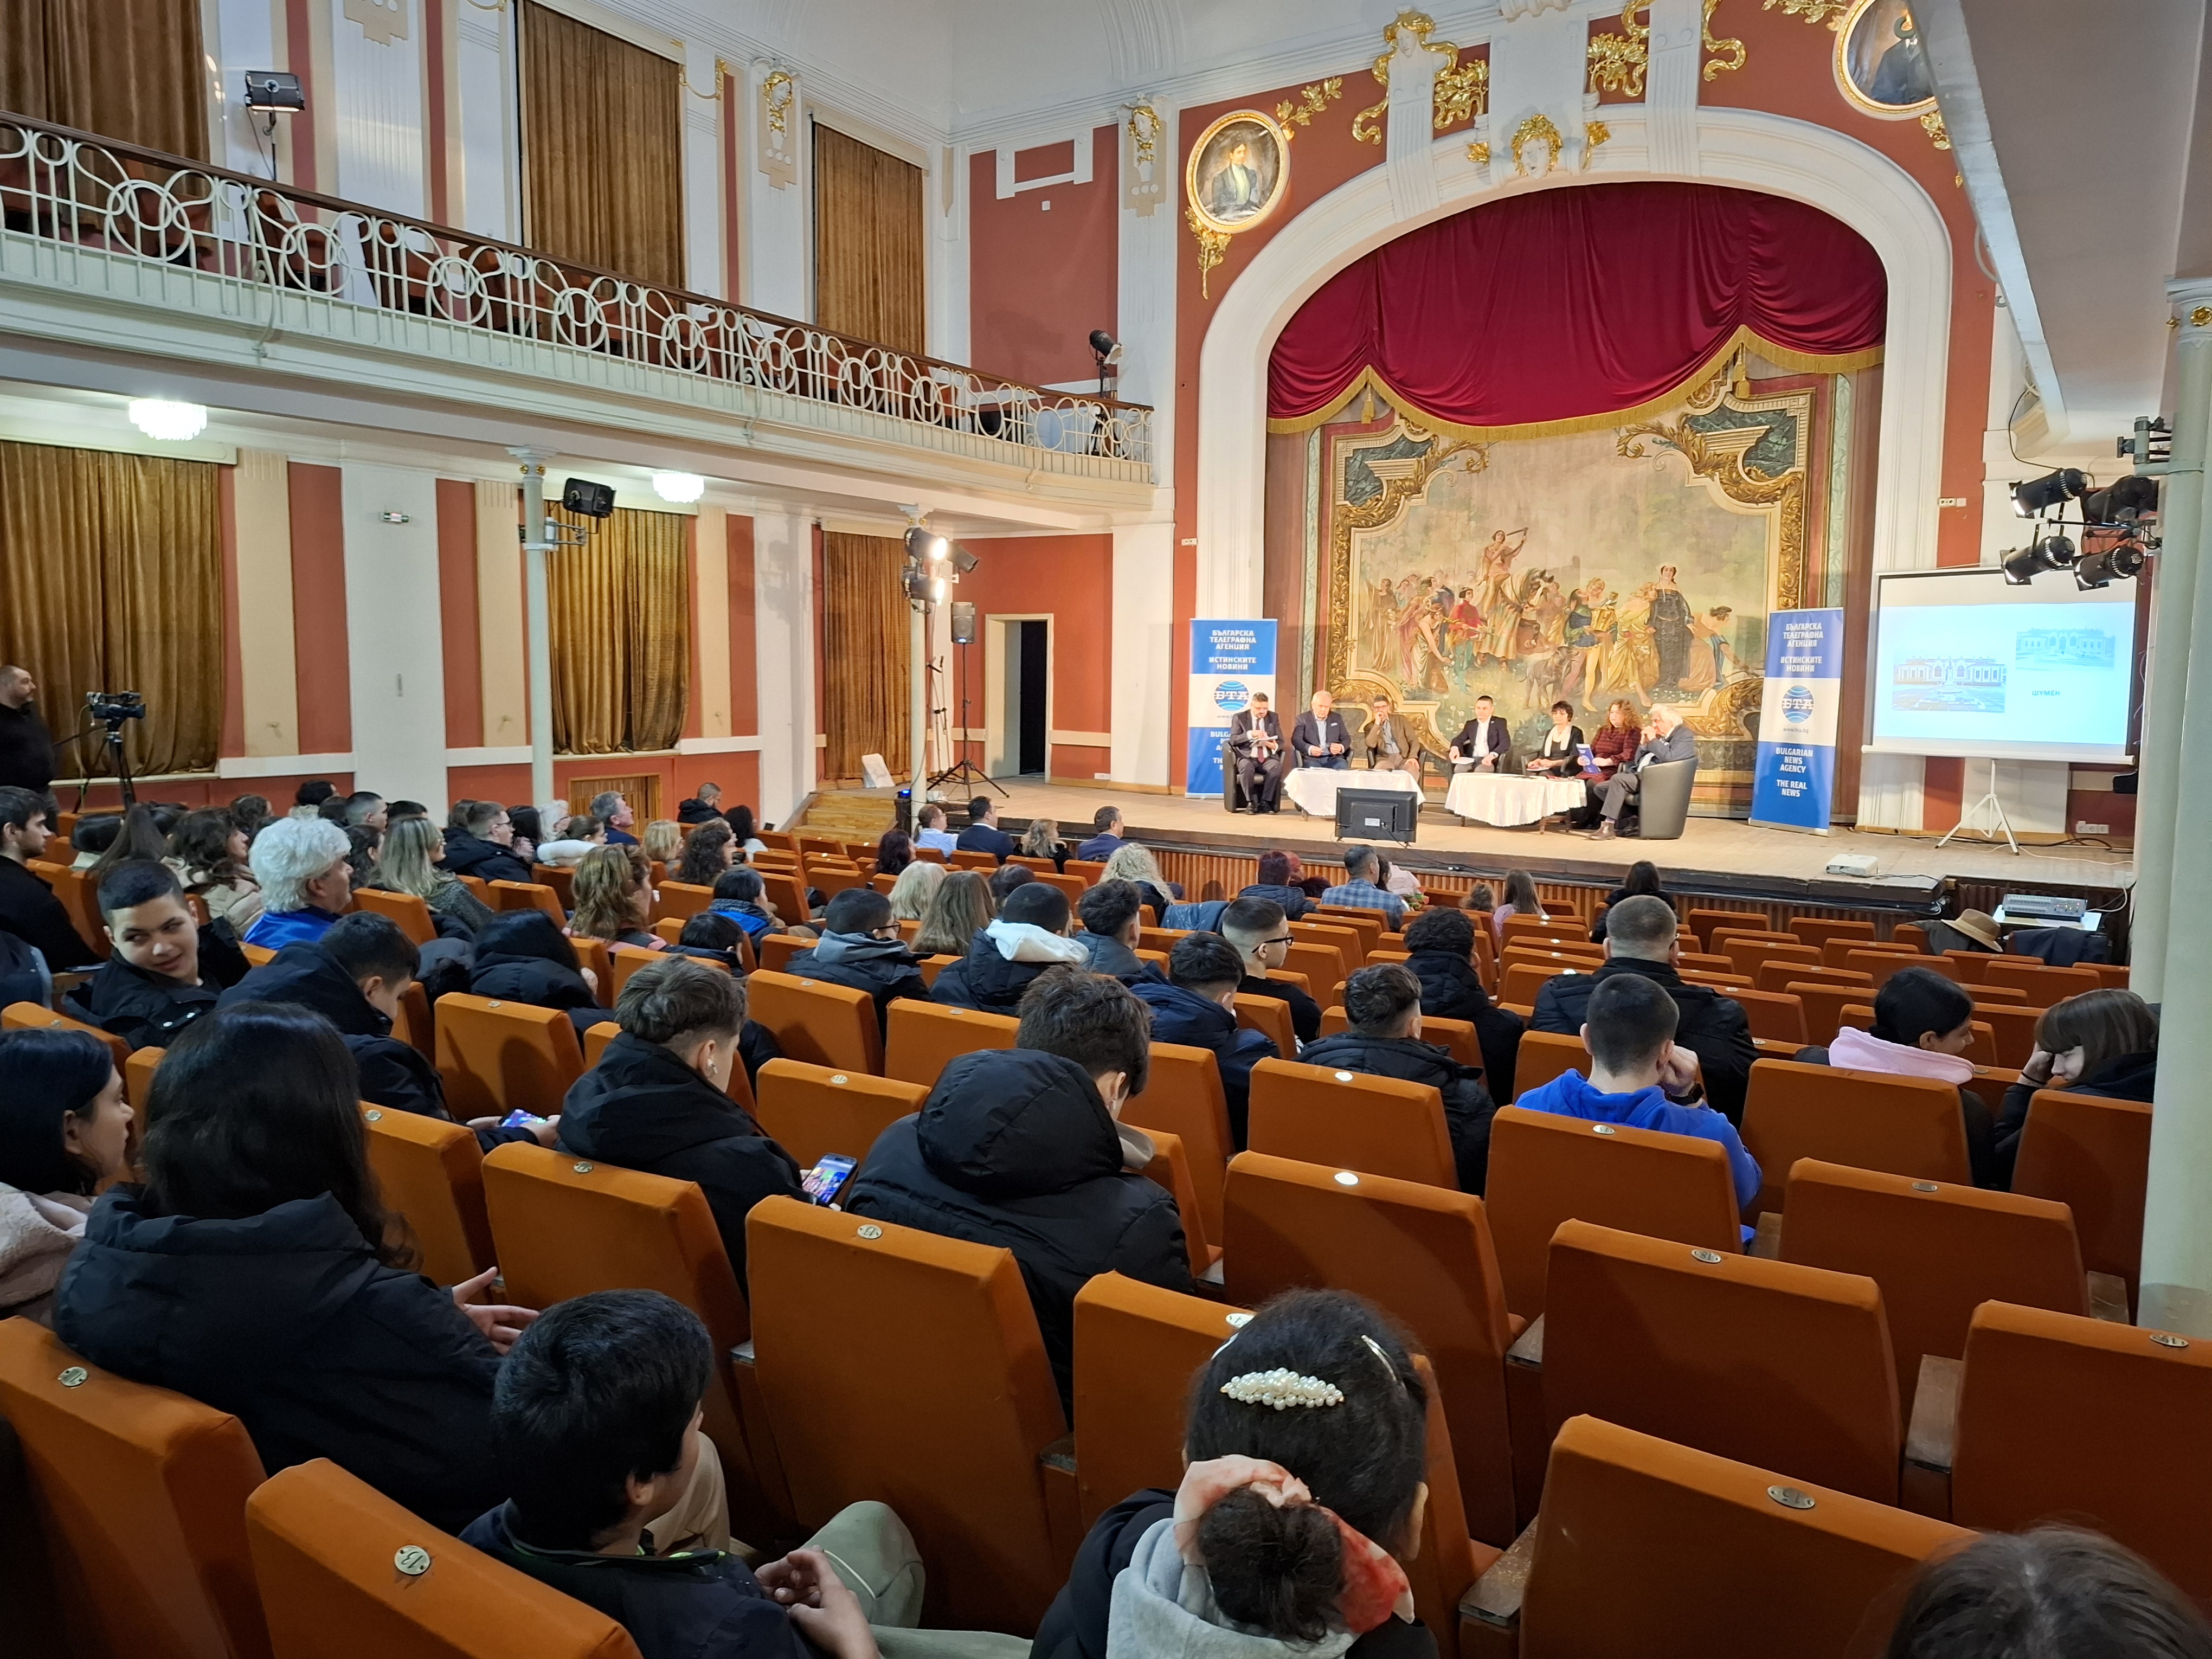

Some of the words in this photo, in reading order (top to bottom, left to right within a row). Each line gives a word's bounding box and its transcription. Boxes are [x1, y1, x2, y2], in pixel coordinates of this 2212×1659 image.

[1783, 631, 1824, 639] ТЕЛЕГРАФНА
[1776, 747, 1813, 757] BULGARIAN
[1784, 756, 1803, 764] NEWS
[1780, 764, 1806, 773] AGENCY
[1790, 781, 1808, 789] REAL
[1782, 788, 1801, 797] NEWS
[401, 1551, 423, 1569] 13
